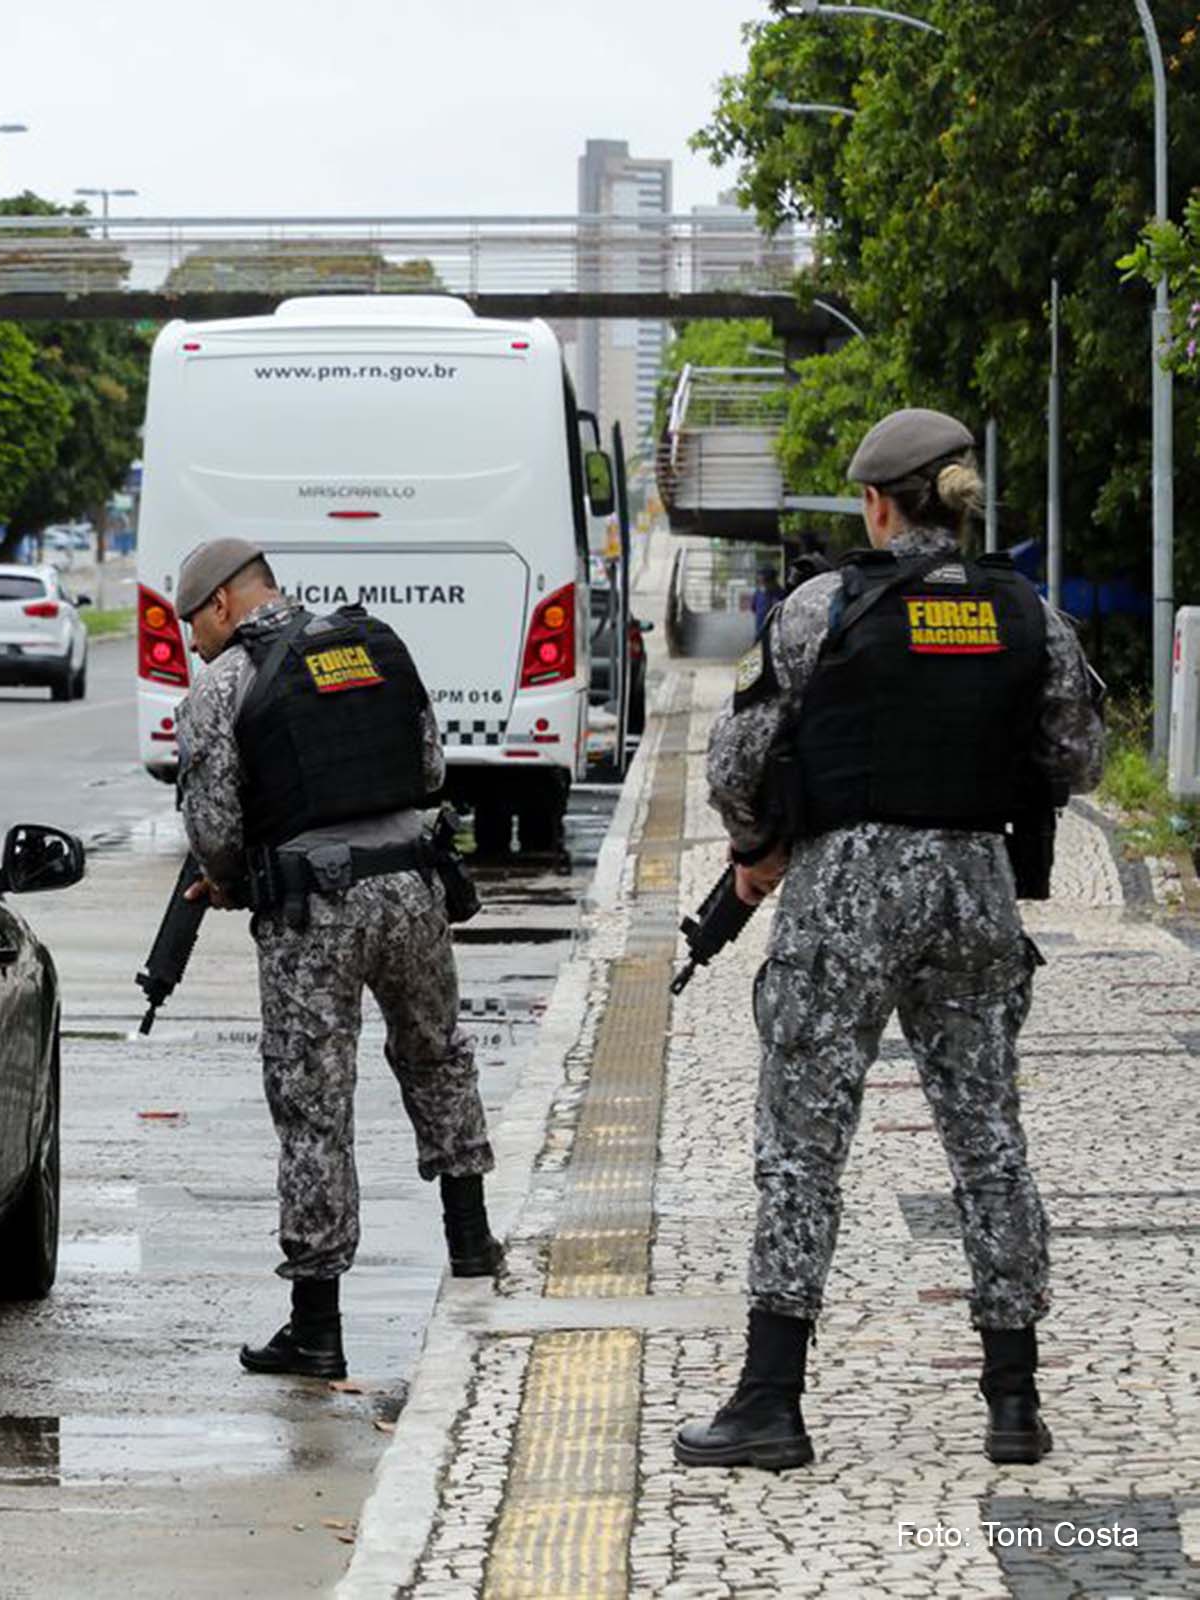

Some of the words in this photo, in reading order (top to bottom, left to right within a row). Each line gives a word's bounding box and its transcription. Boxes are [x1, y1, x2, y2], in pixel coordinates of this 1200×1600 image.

[254, 364, 457, 381] www.pm.rn.gov.br
[358, 585, 465, 604] MILITAR
[911, 628, 1001, 645] NACIONAL
[468, 689, 503, 704] 016
